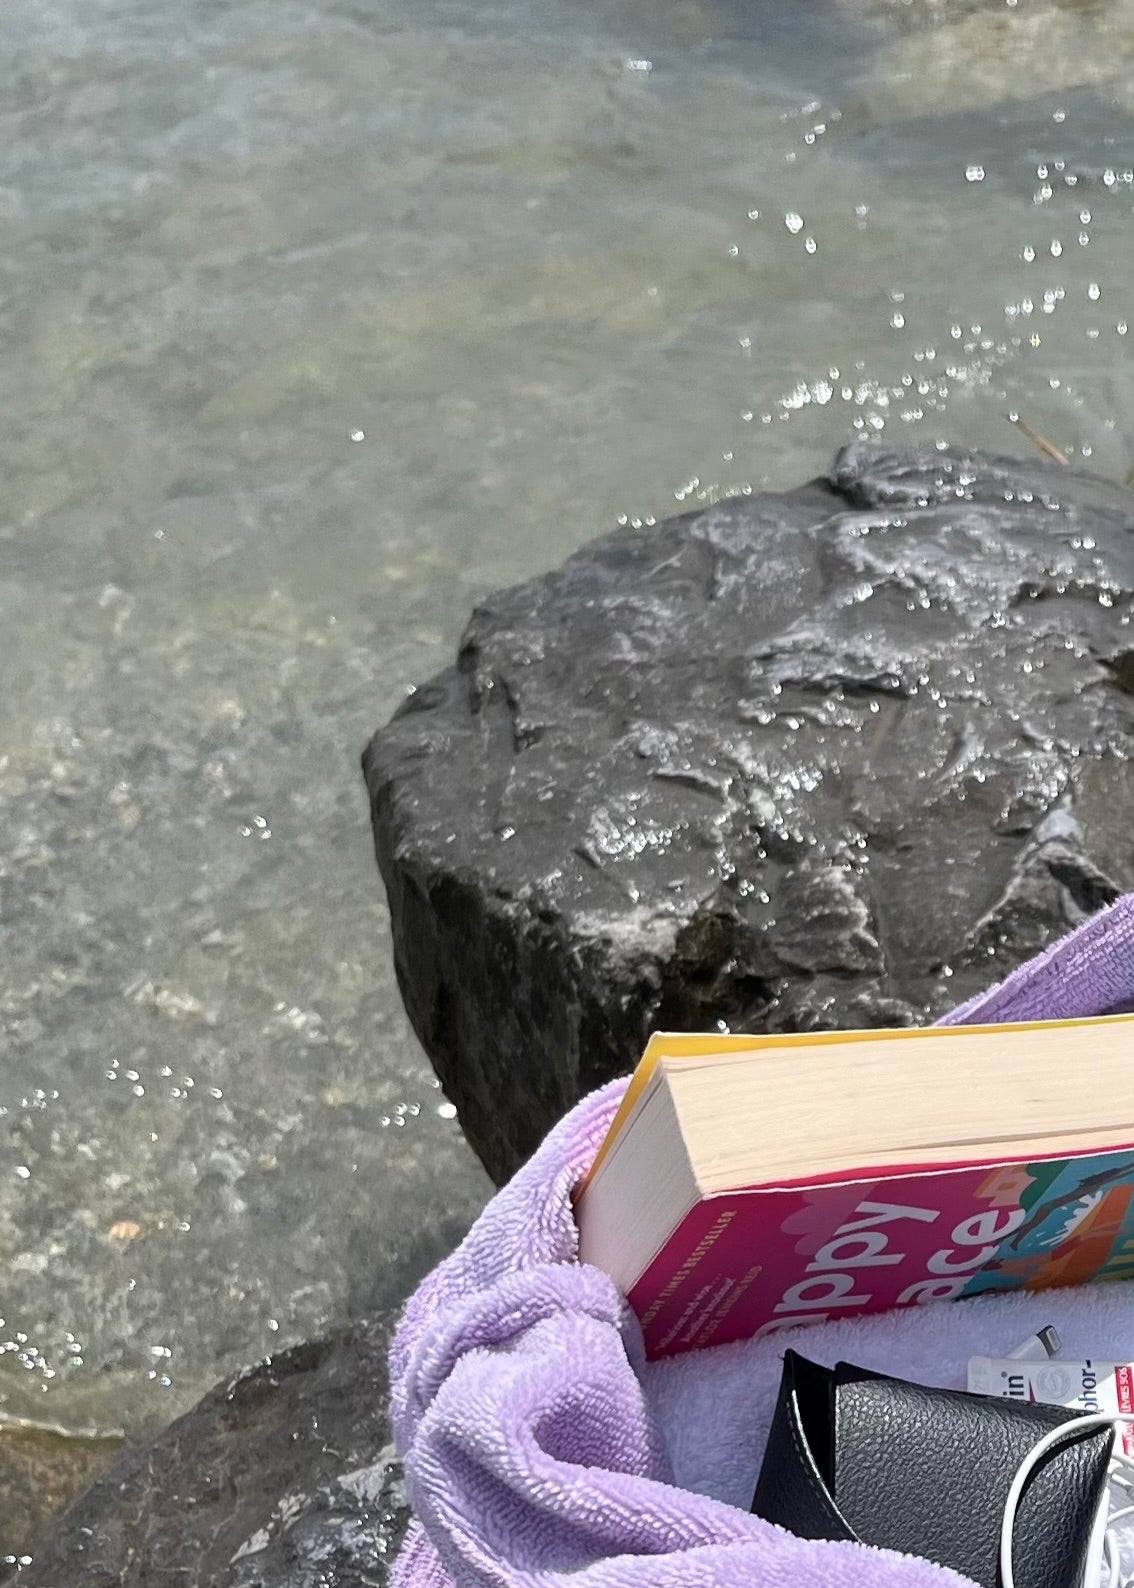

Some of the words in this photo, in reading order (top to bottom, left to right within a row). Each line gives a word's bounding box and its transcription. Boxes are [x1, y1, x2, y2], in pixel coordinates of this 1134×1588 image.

[659, 1270, 691, 1297] TIMES
[682, 1211, 737, 1268] BESTSELLER
[754, 1201, 941, 1341] appy
[896, 1209, 1026, 1304] ace
[1078, 1371, 1104, 1412] phor
[1118, 1367, 1128, 1384] SOS
